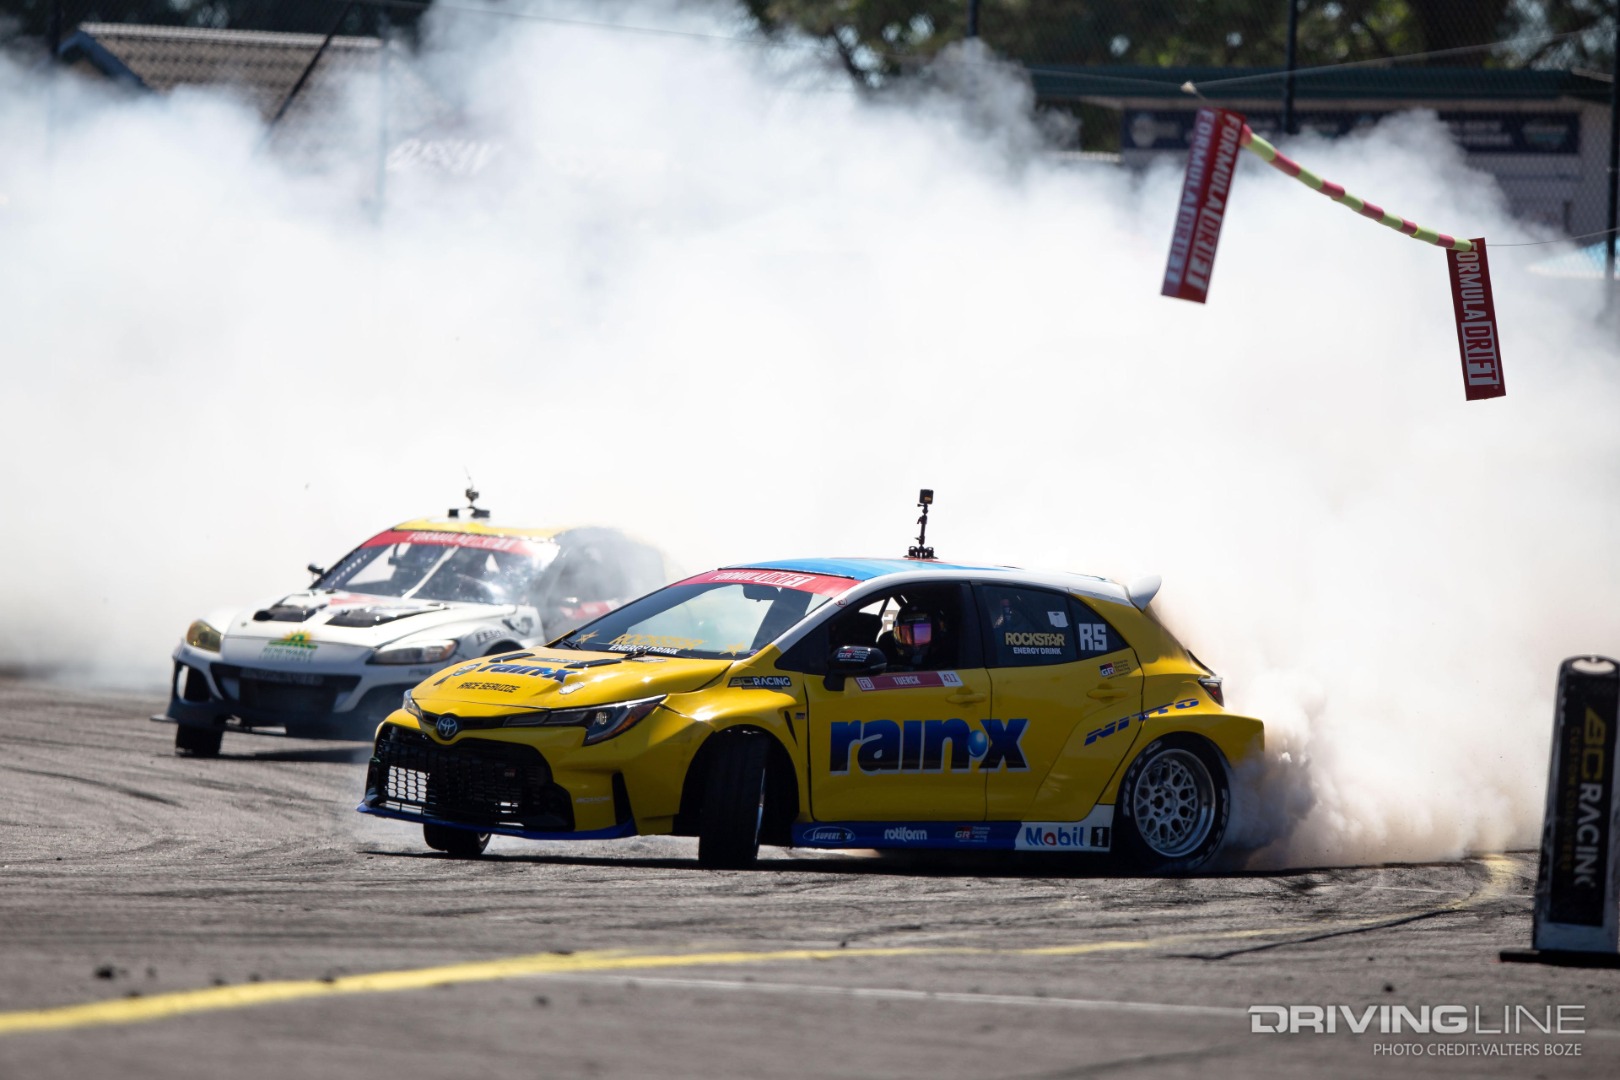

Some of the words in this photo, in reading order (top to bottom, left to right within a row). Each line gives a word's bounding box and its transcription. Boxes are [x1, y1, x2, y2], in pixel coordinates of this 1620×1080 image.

[1206, 113, 1242, 208] FORMULA
[1464, 324, 1498, 382] DRIFT
[1005, 632, 1066, 646] ROCKSTAR
[1079, 623, 1107, 651] RS
[648, 646, 680, 655] DRINK
[1013, 646, 1041, 655] ENERGY
[1041, 647, 1062, 655] DRINK
[943, 672, 958, 683] 411
[1101, 667, 1116, 677] GR
[892, 675, 921, 686] TUERCK
[1084, 698, 1199, 747] NITTO
[884, 826, 928, 843] rotiform
[954, 830, 971, 839] GR
[1025, 827, 1084, 847] Mobil
